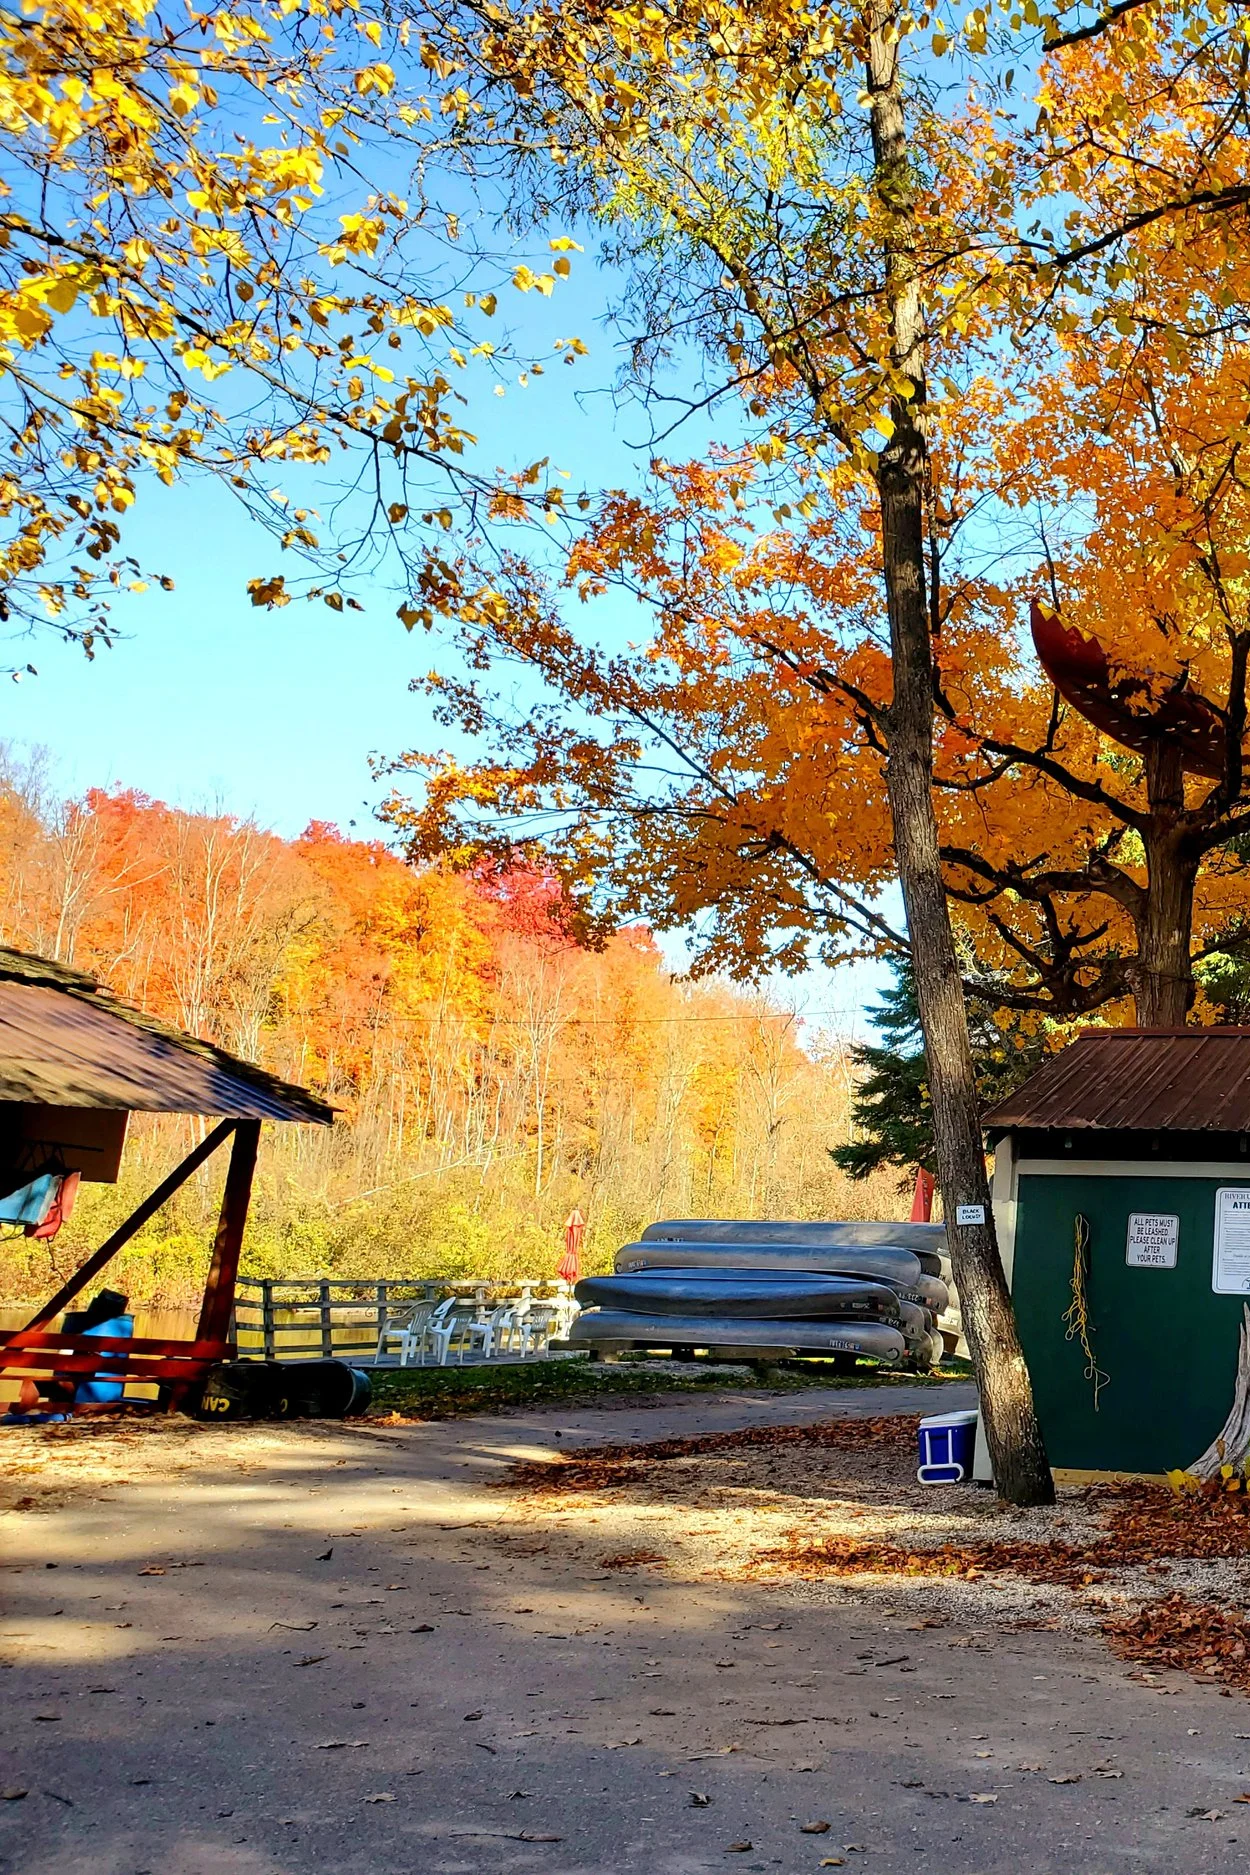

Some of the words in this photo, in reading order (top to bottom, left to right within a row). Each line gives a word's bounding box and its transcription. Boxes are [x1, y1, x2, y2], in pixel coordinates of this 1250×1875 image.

[1134, 1218, 1144, 1226] ALL
[1145, 1218, 1159, 1227] PETS
[1159, 1219, 1174, 1228] MUST
[1137, 1227, 1144, 1235] BE
[1130, 1236, 1150, 1244] PLEASE
[1150, 1237, 1168, 1245] CLEAN
[1168, 1237, 1176, 1246] UP
[1144, 1246, 1161, 1254] AFTER
[1137, 1254, 1151, 1262] YOUR
